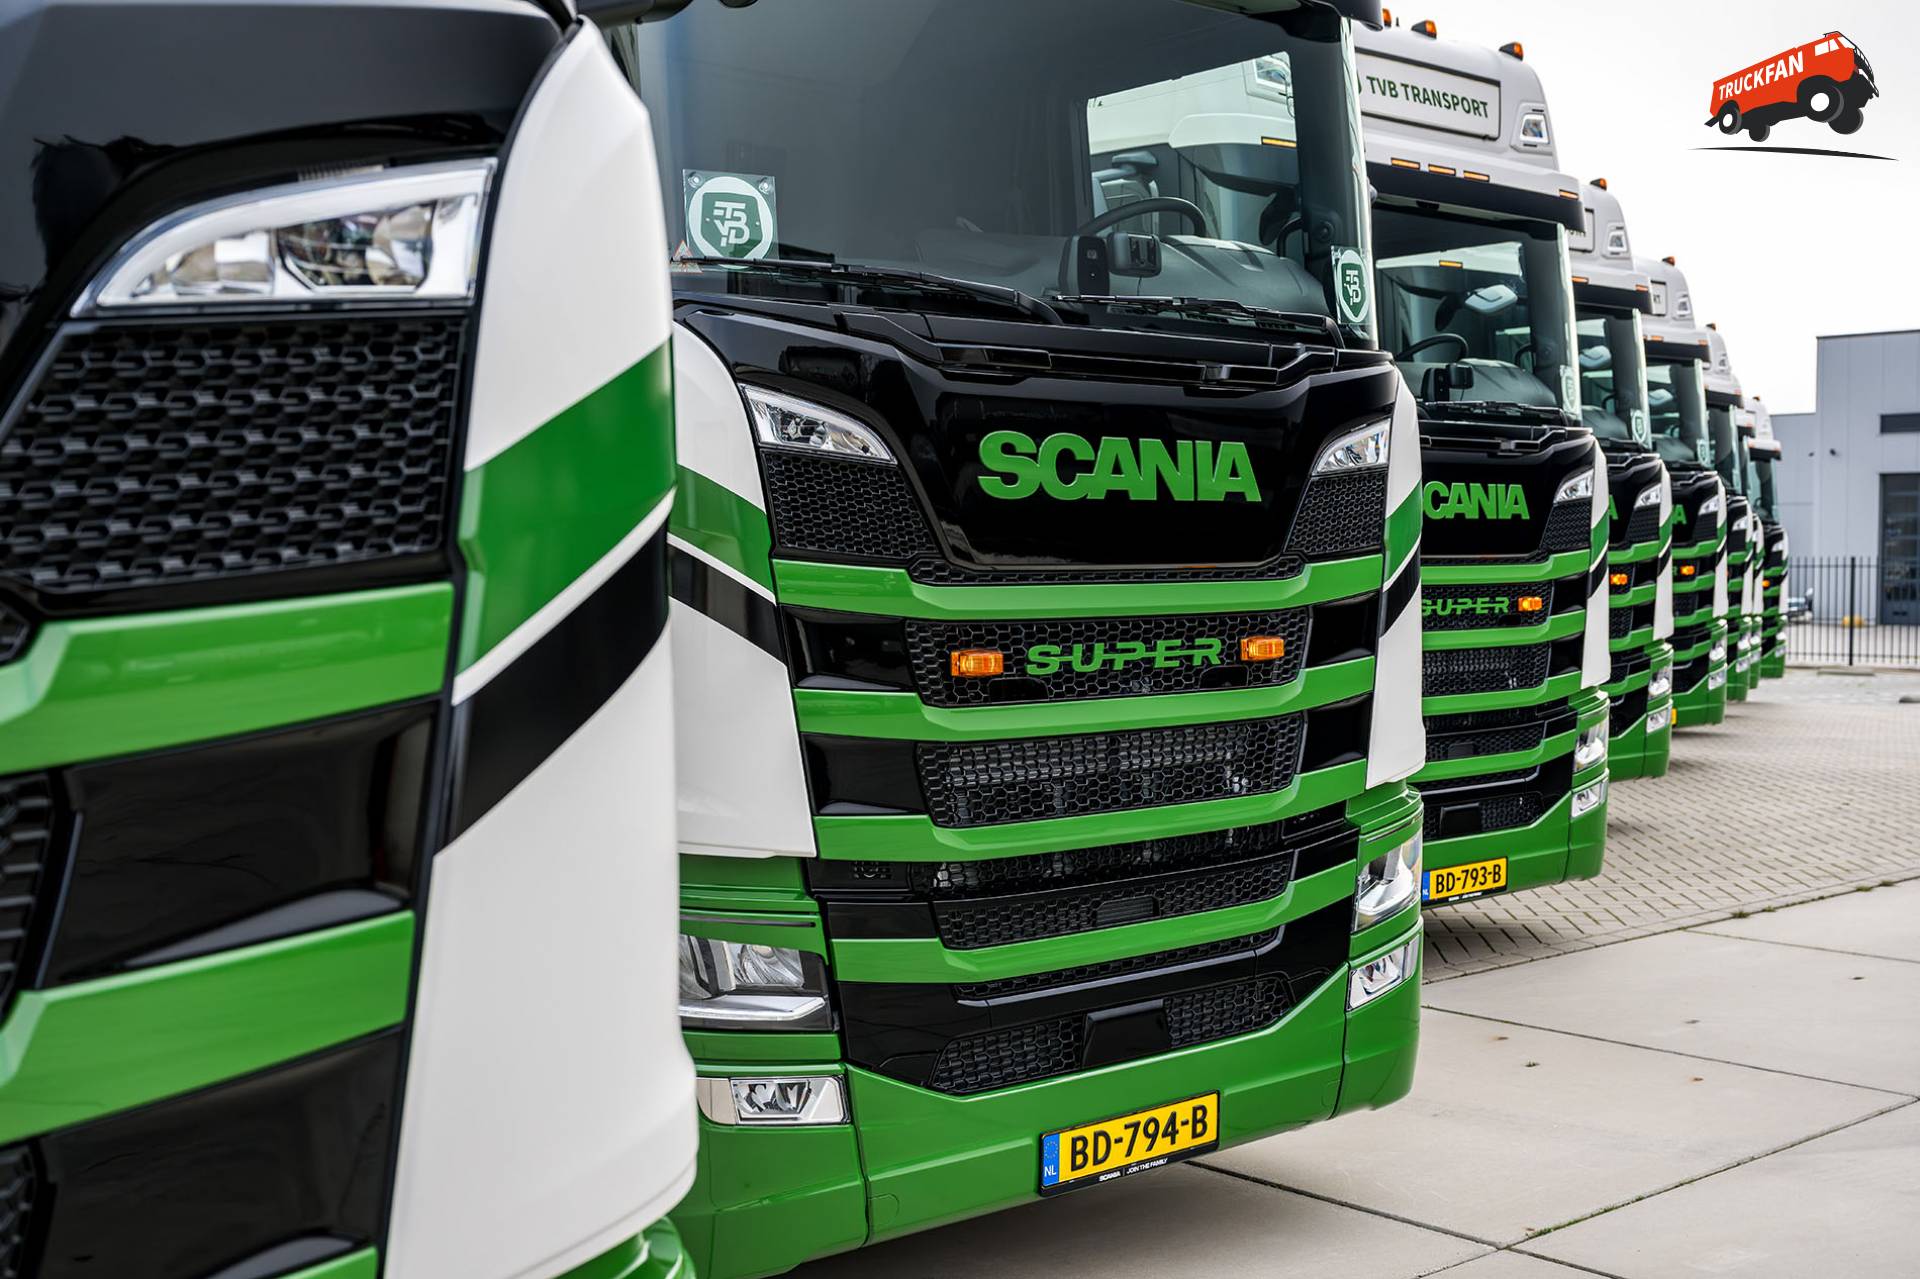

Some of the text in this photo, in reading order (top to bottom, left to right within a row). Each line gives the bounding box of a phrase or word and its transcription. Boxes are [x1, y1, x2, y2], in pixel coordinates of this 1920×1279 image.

[1366, 75, 1488, 118] TVB TRANSPORT
[977, 430, 1262, 502] SCANIA
[1422, 481, 1530, 519] CANIA
[1422, 597, 1510, 616] SUPER
[1026, 638, 1222, 675] SUPER
[1436, 864, 1501, 894] BD-793-B
[1071, 1104, 1208, 1172] BD-794-B
[1044, 1165, 1057, 1177] NL
[1099, 1157, 1168, 1182] SCANIA JOIN THE FAMILY
